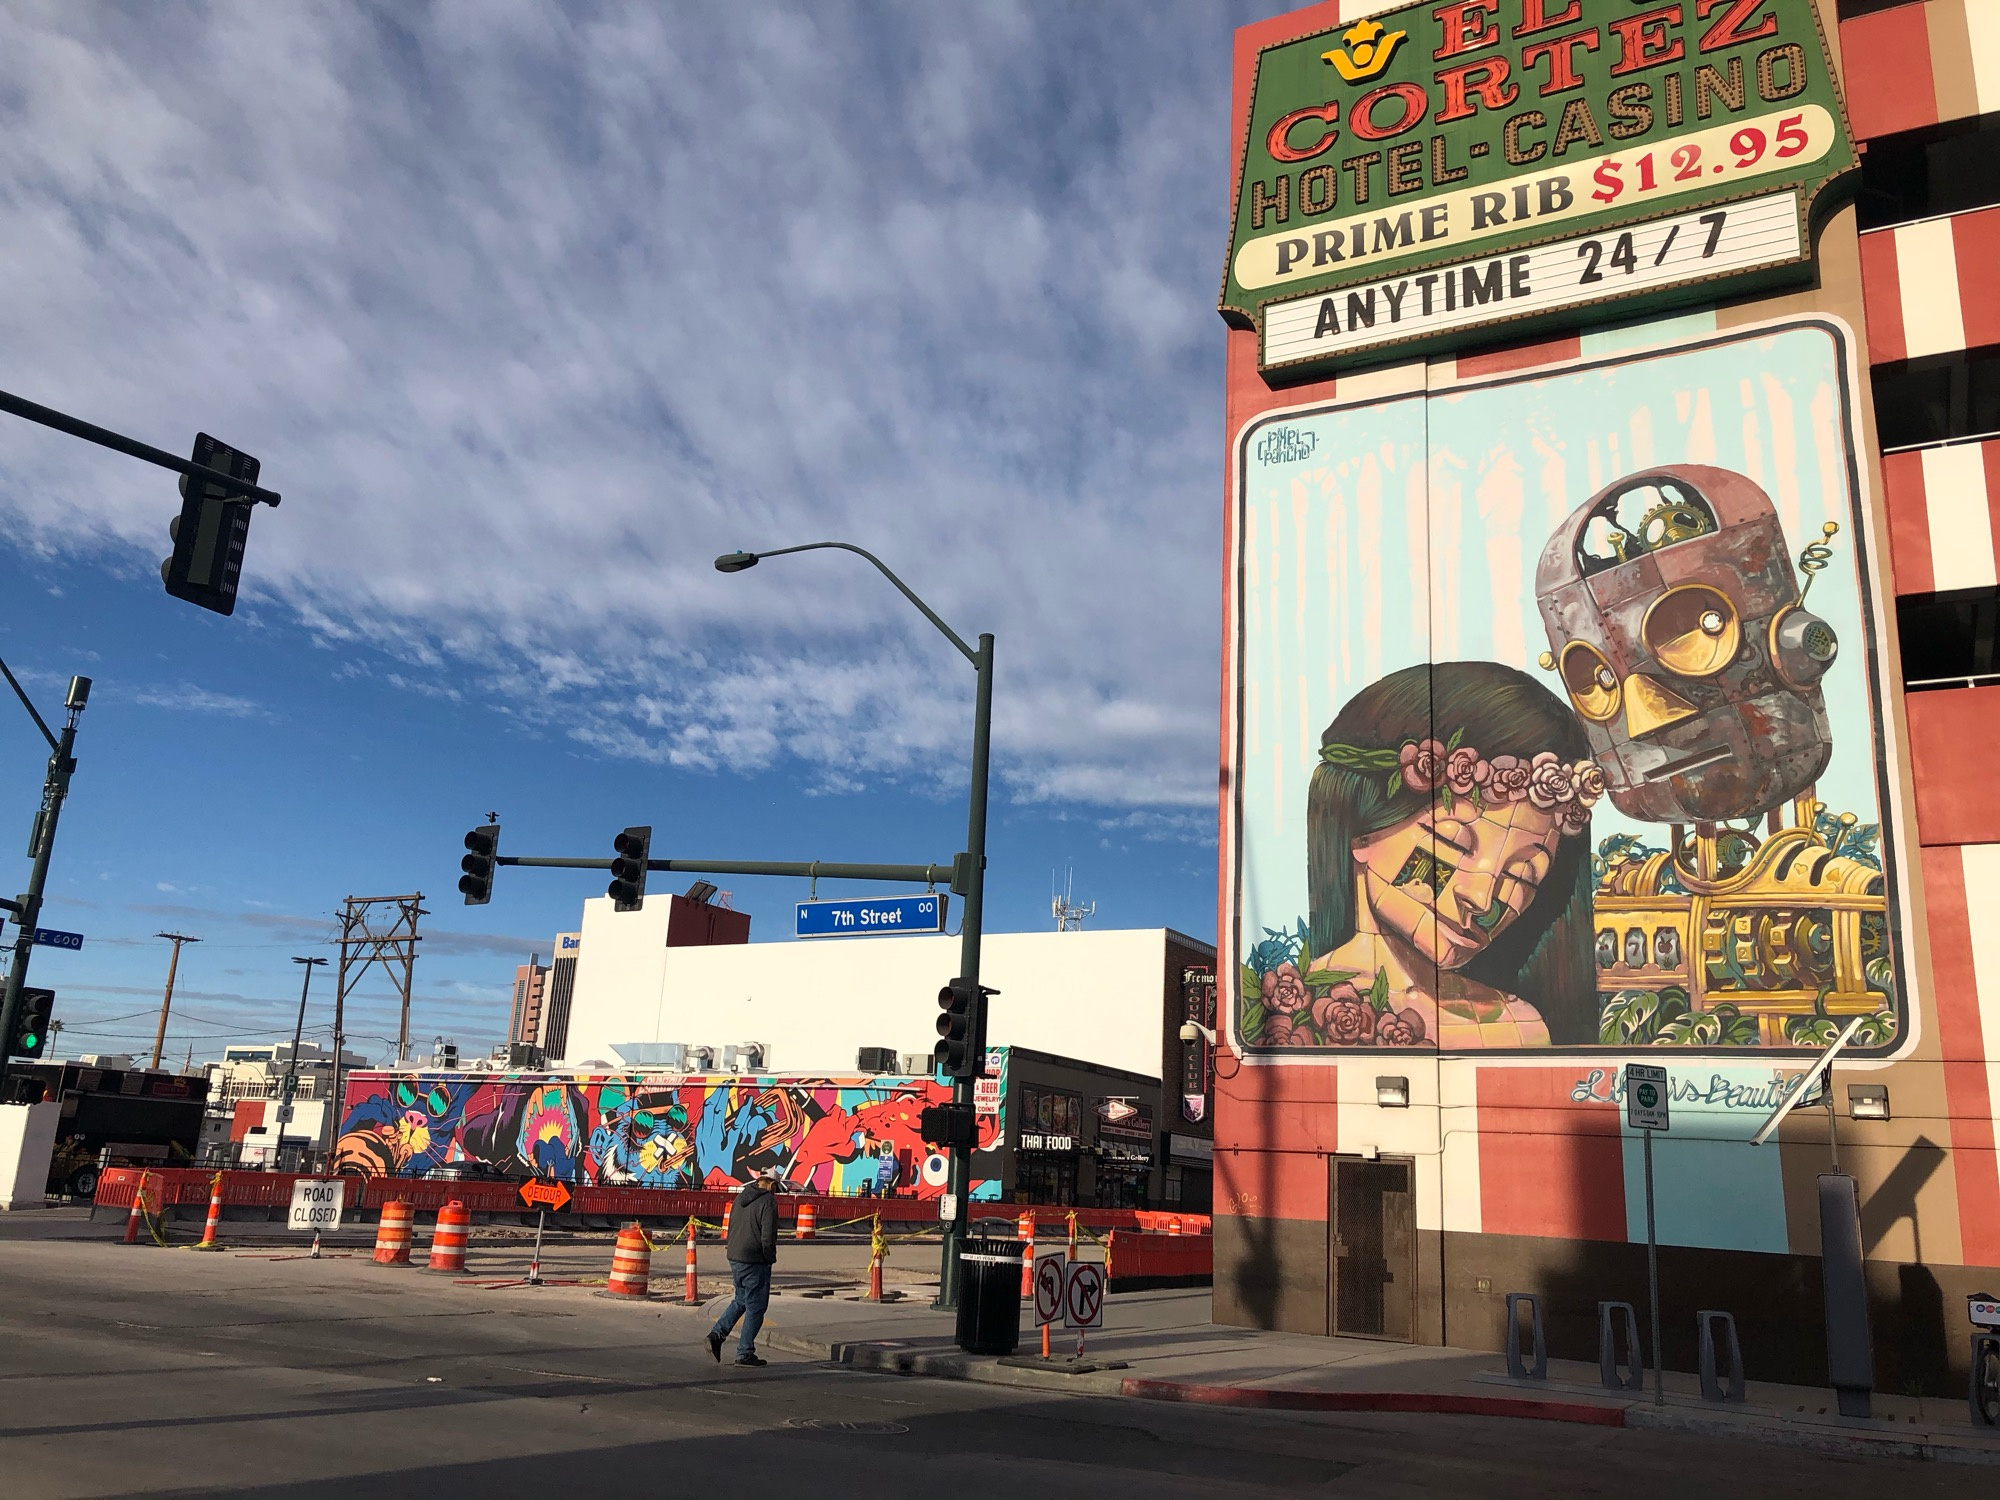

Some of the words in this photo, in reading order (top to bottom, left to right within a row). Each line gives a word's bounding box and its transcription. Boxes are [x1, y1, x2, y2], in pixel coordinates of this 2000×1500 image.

[1432, 0, 1583, 62] EL
[1266, 0, 1779, 164] CORTEZ
[1276, 202, 1449, 276] PRIME
[1470, 174, 1575, 232] RIB
[1591, 113, 1809, 204] $12.95
[1313, 255, 1532, 339] ANYTIME
[800, 909, 808, 919] N
[831, 910, 855, 926] 7th
[860, 907, 902, 925] Street
[40, 932, 47, 941] E
[53, 934, 80, 946] 600
[1628, 942, 1640, 957] 7
[1183, 970, 1217, 985] Fremo
[1188, 1054, 1199, 1090] CLUB
[1630, 1068, 1635, 1077] 4
[1636, 1068, 1645, 1078] HR
[1647, 1069, 1664, 1080] LIMIT
[287, 1076, 296, 1090] P
[981, 1082, 998, 1094] BEER
[1131, 1117, 1150, 1132] Gallery
[1021, 1135, 1043, 1149] THAI
[1046, 1136, 1072, 1150] FOOD
[1130, 1154, 1149, 1162] Gallery
[303, 1187, 334, 1202] ROAD
[527, 1186, 562, 1202] DETOUR
[294, 1207, 337, 1222] CLOSED
